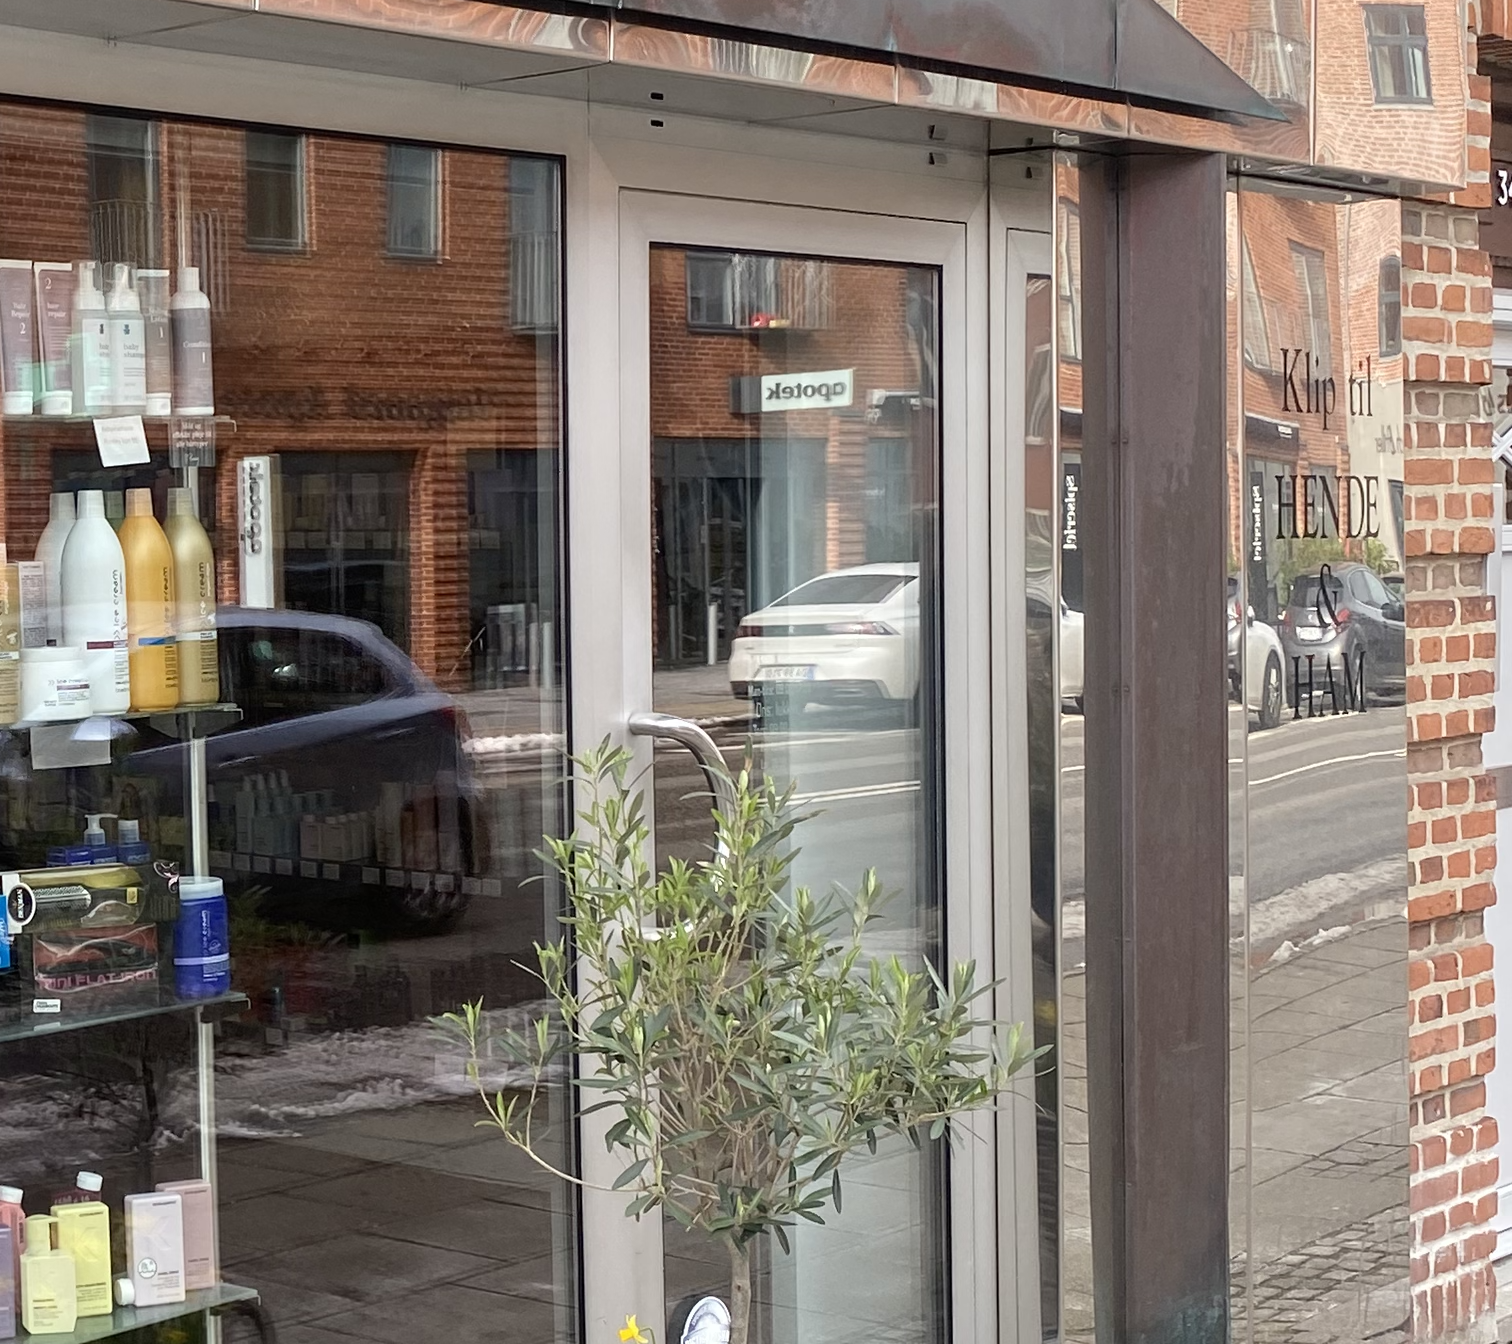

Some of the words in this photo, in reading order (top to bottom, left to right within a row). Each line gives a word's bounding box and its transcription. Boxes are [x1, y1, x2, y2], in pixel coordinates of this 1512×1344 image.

[1497, 169, 1512, 206] 3
[1280, 346, 1338, 432] Klip
[1347, 354, 1374, 417] til
[1274, 475, 1381, 540] HENDE
[1315, 563, 1344, 628] &
[1292, 650, 1367, 720] HAM
